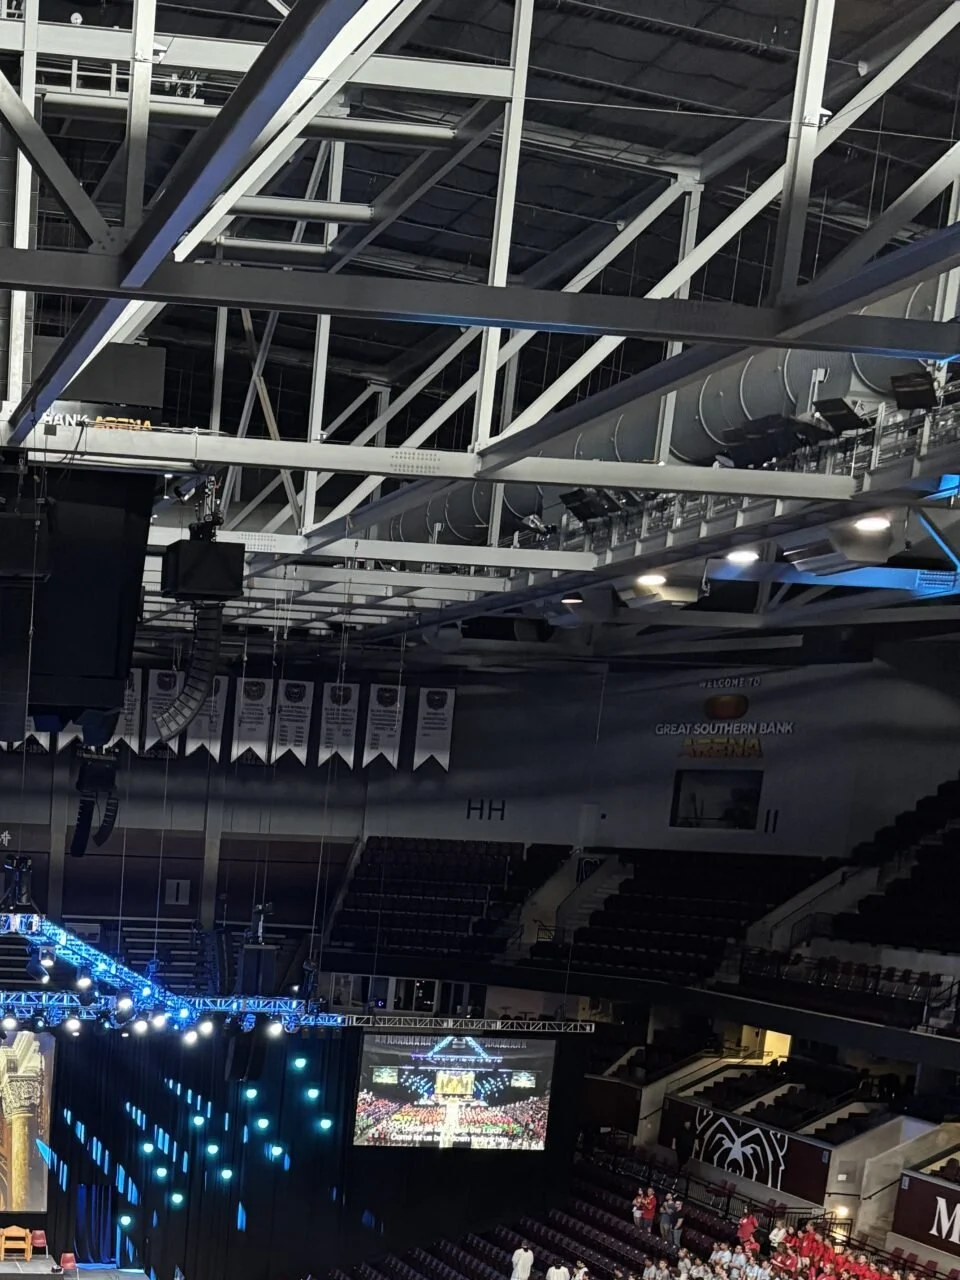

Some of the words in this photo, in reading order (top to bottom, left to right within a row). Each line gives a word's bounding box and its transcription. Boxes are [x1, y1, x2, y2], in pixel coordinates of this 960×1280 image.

[699, 676, 745, 688] WELCOME
[748, 676, 761, 687] TO
[655, 723, 692, 736] GREAT
[693, 722, 758, 736] SOUTHERN
[759, 721, 794, 735] BANK
[466, 798, 506, 821] HH
